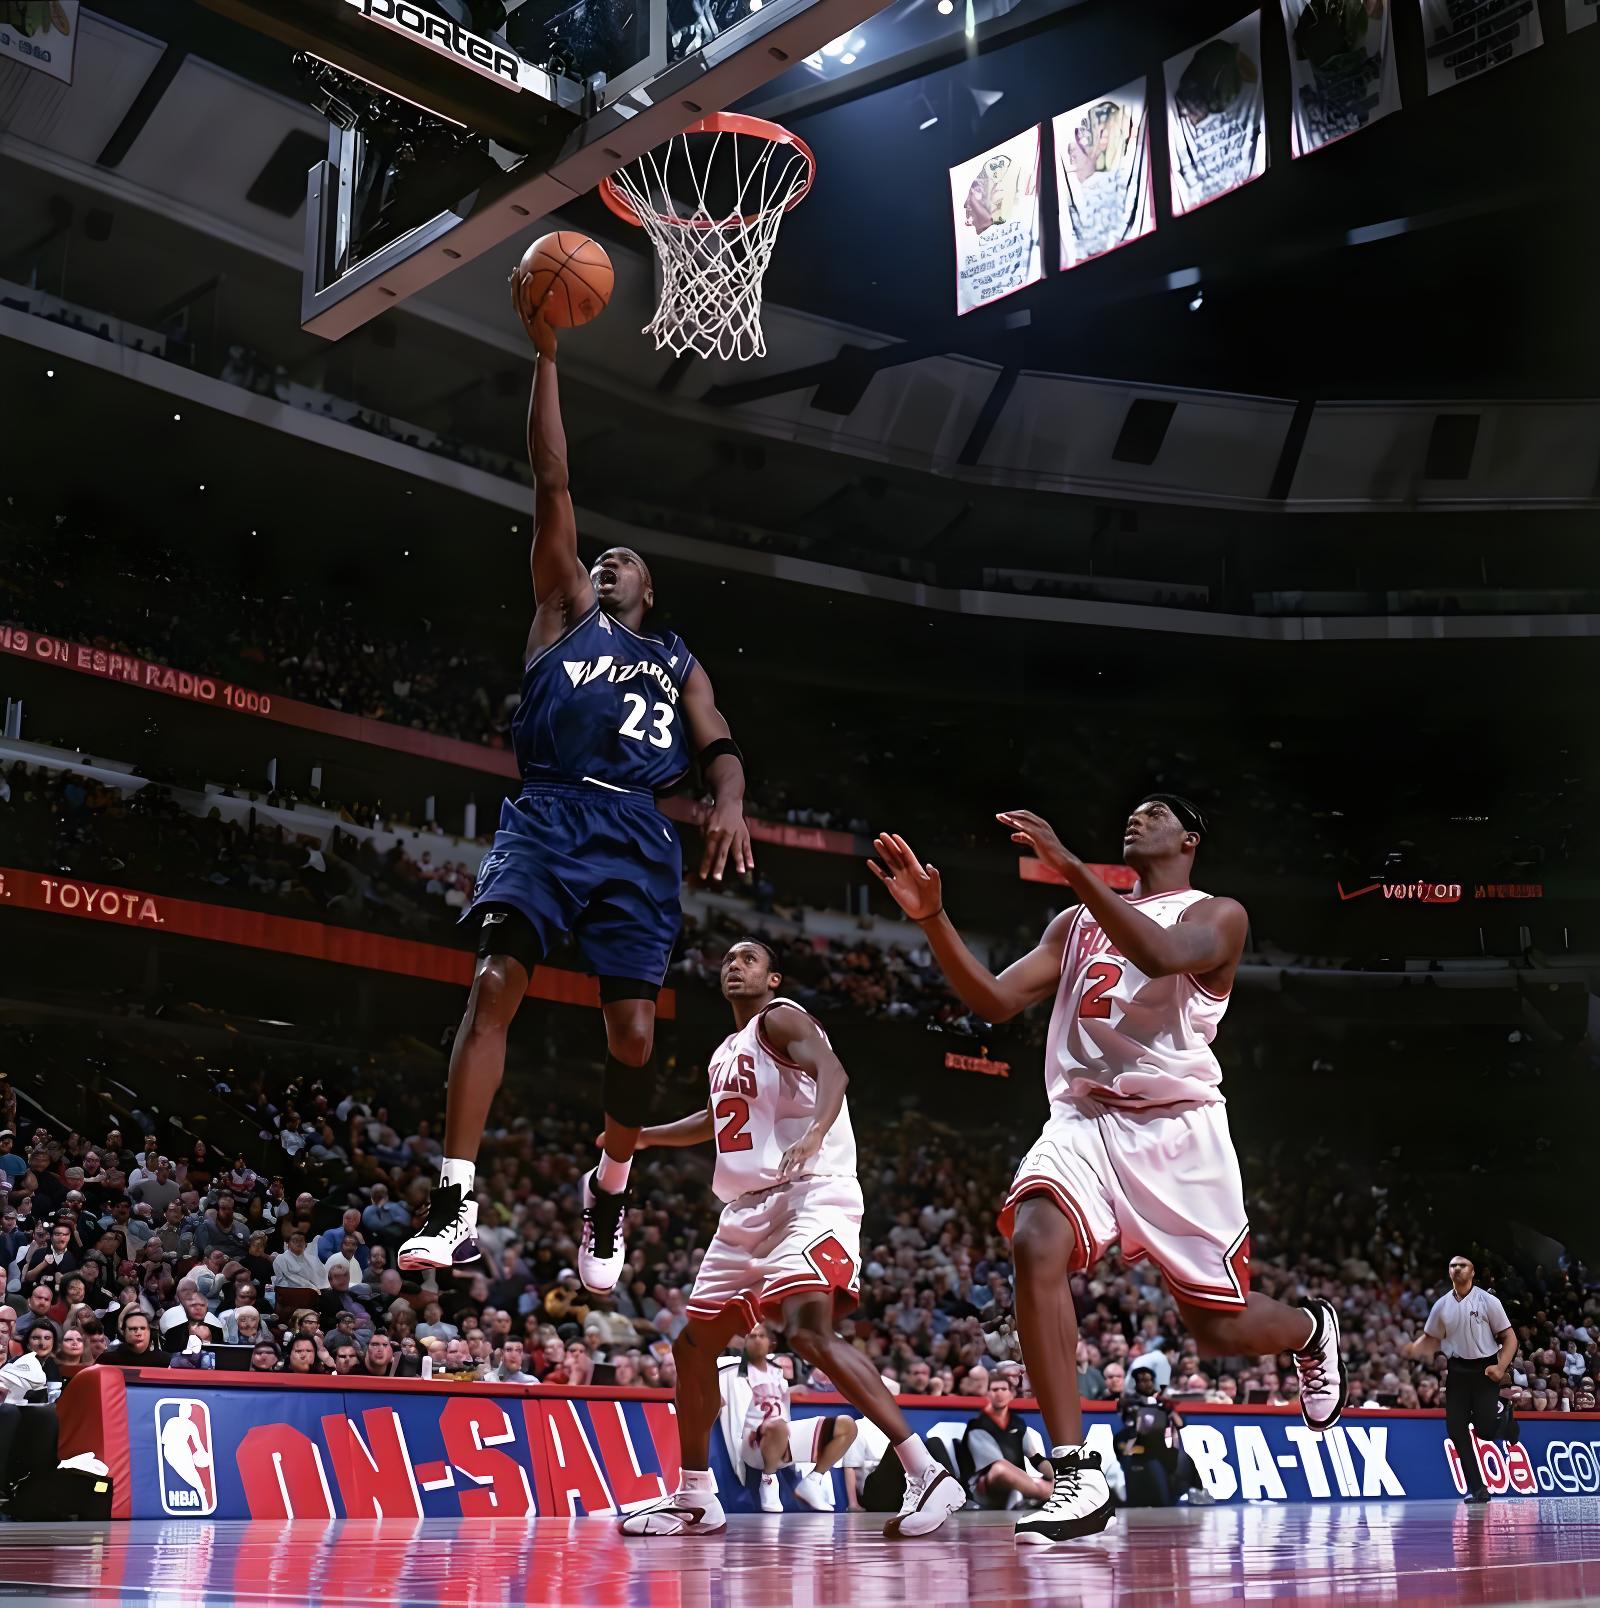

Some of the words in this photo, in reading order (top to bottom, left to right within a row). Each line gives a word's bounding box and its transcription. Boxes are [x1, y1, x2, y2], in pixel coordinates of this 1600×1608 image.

[36, 637, 69, 662] ON
[78, 647, 138, 681] ESPN
[146, 666, 216, 699] RADIO
[223, 686, 271, 714] 1000
[563, 655, 679, 704] WIZARDS
[618, 692, 675, 749] 23
[1079, 961, 1123, 1019] 2
[715, 1097, 753, 1153] 2
[169, 1490, 200, 1506] NBA
